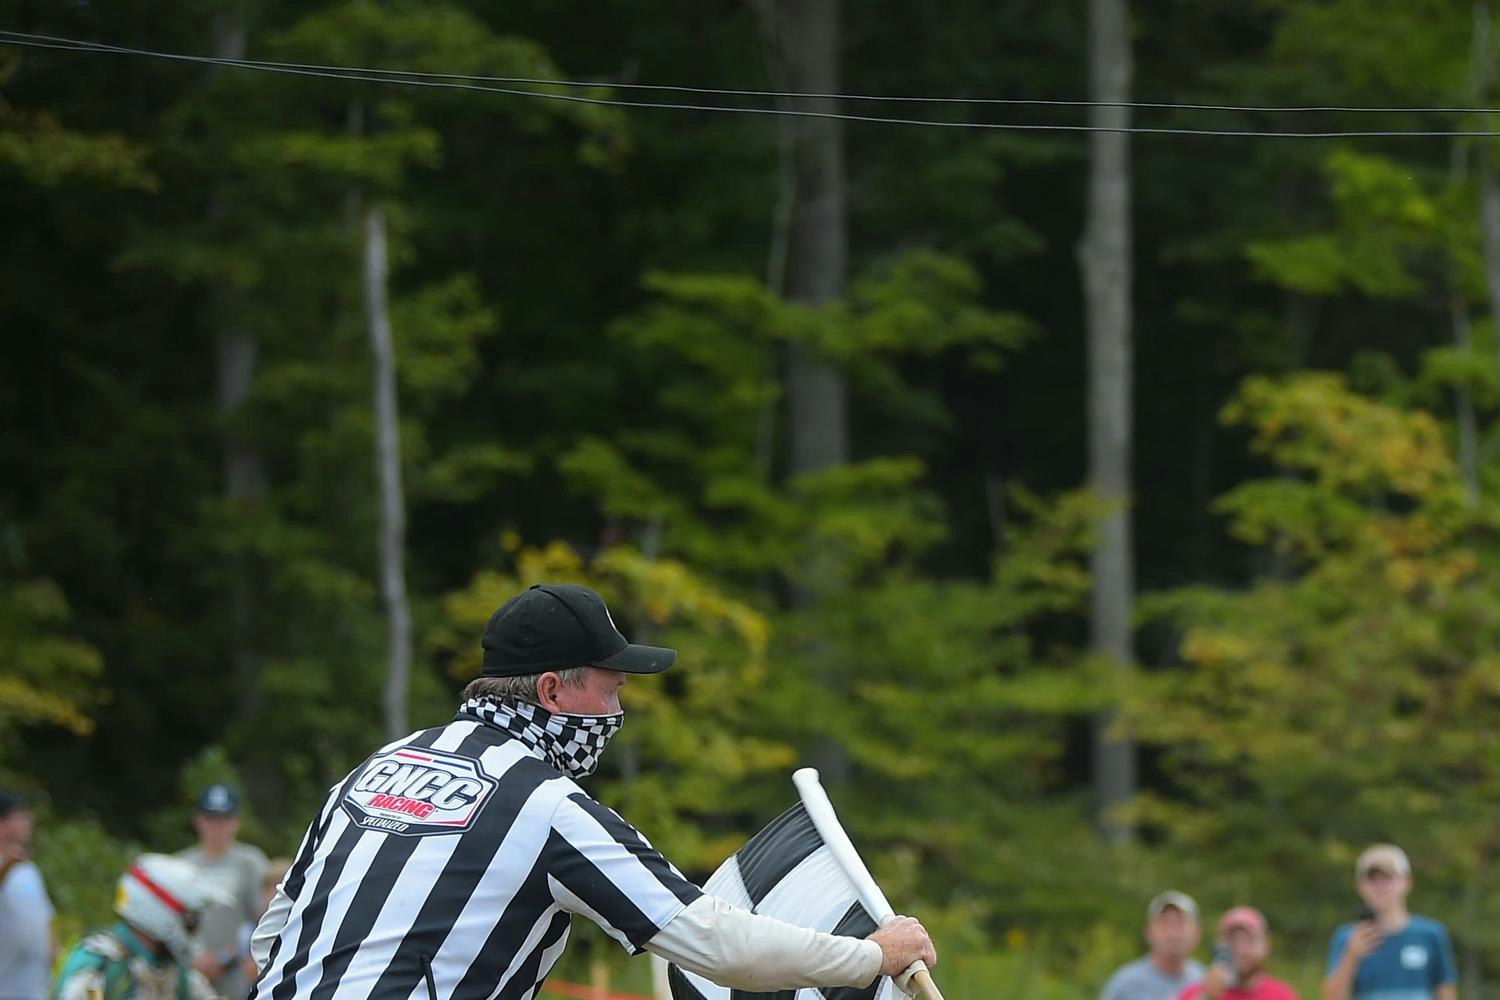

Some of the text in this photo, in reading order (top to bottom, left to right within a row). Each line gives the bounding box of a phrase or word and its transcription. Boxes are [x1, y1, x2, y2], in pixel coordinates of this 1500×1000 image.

[354, 760, 483, 811] GNCC
[367, 794, 435, 819] RACING
[359, 816, 409, 832] SPECIALIZED
